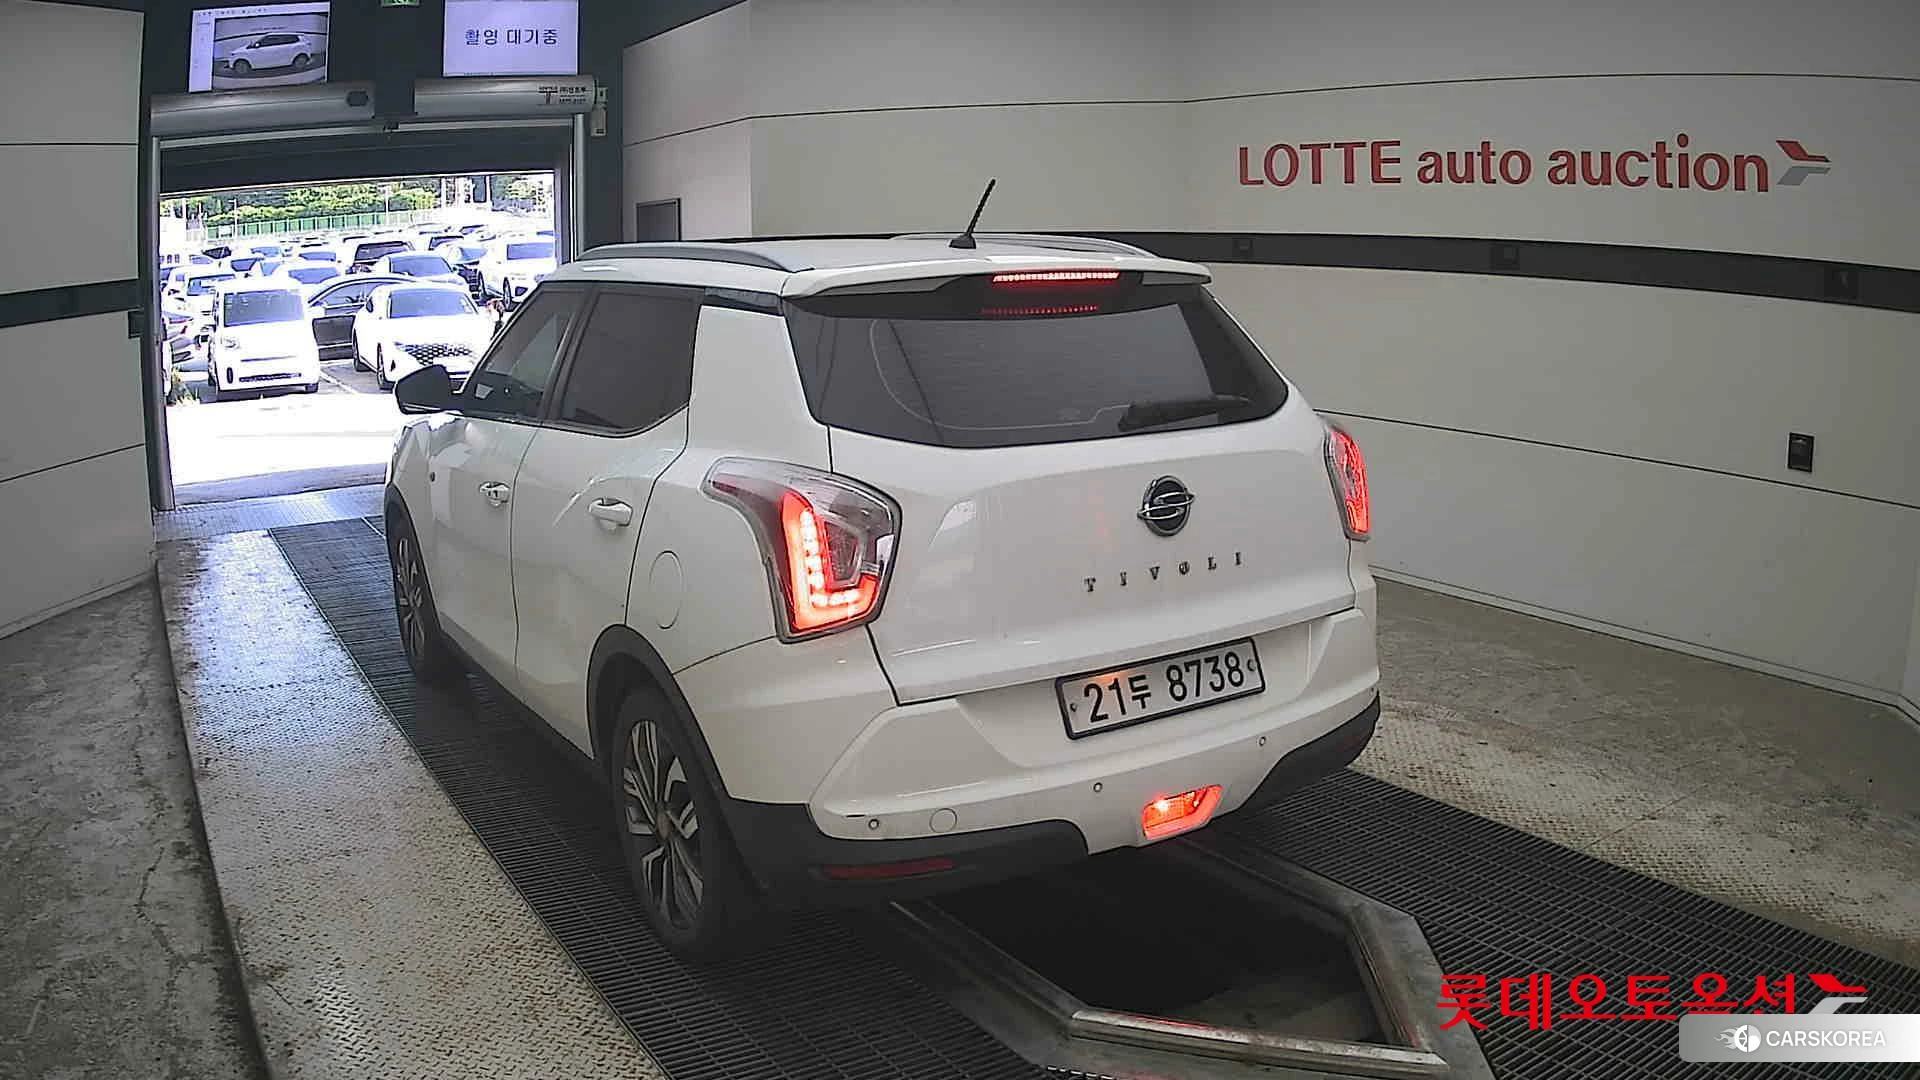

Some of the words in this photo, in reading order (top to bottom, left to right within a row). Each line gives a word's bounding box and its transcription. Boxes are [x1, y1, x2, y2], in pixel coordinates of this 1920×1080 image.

[464, 29, 498, 45] 촬영
[506, 29, 557, 45] 대기중
[1239, 139, 1402, 187] LOTTE
[1416, 141, 1532, 185] auto
[1547, 132, 1770, 193] auction
[1084, 551, 1242, 592] TIVOLI
[1083, 673, 1152, 723] 21두
[1165, 651, 1244, 702] 8738
